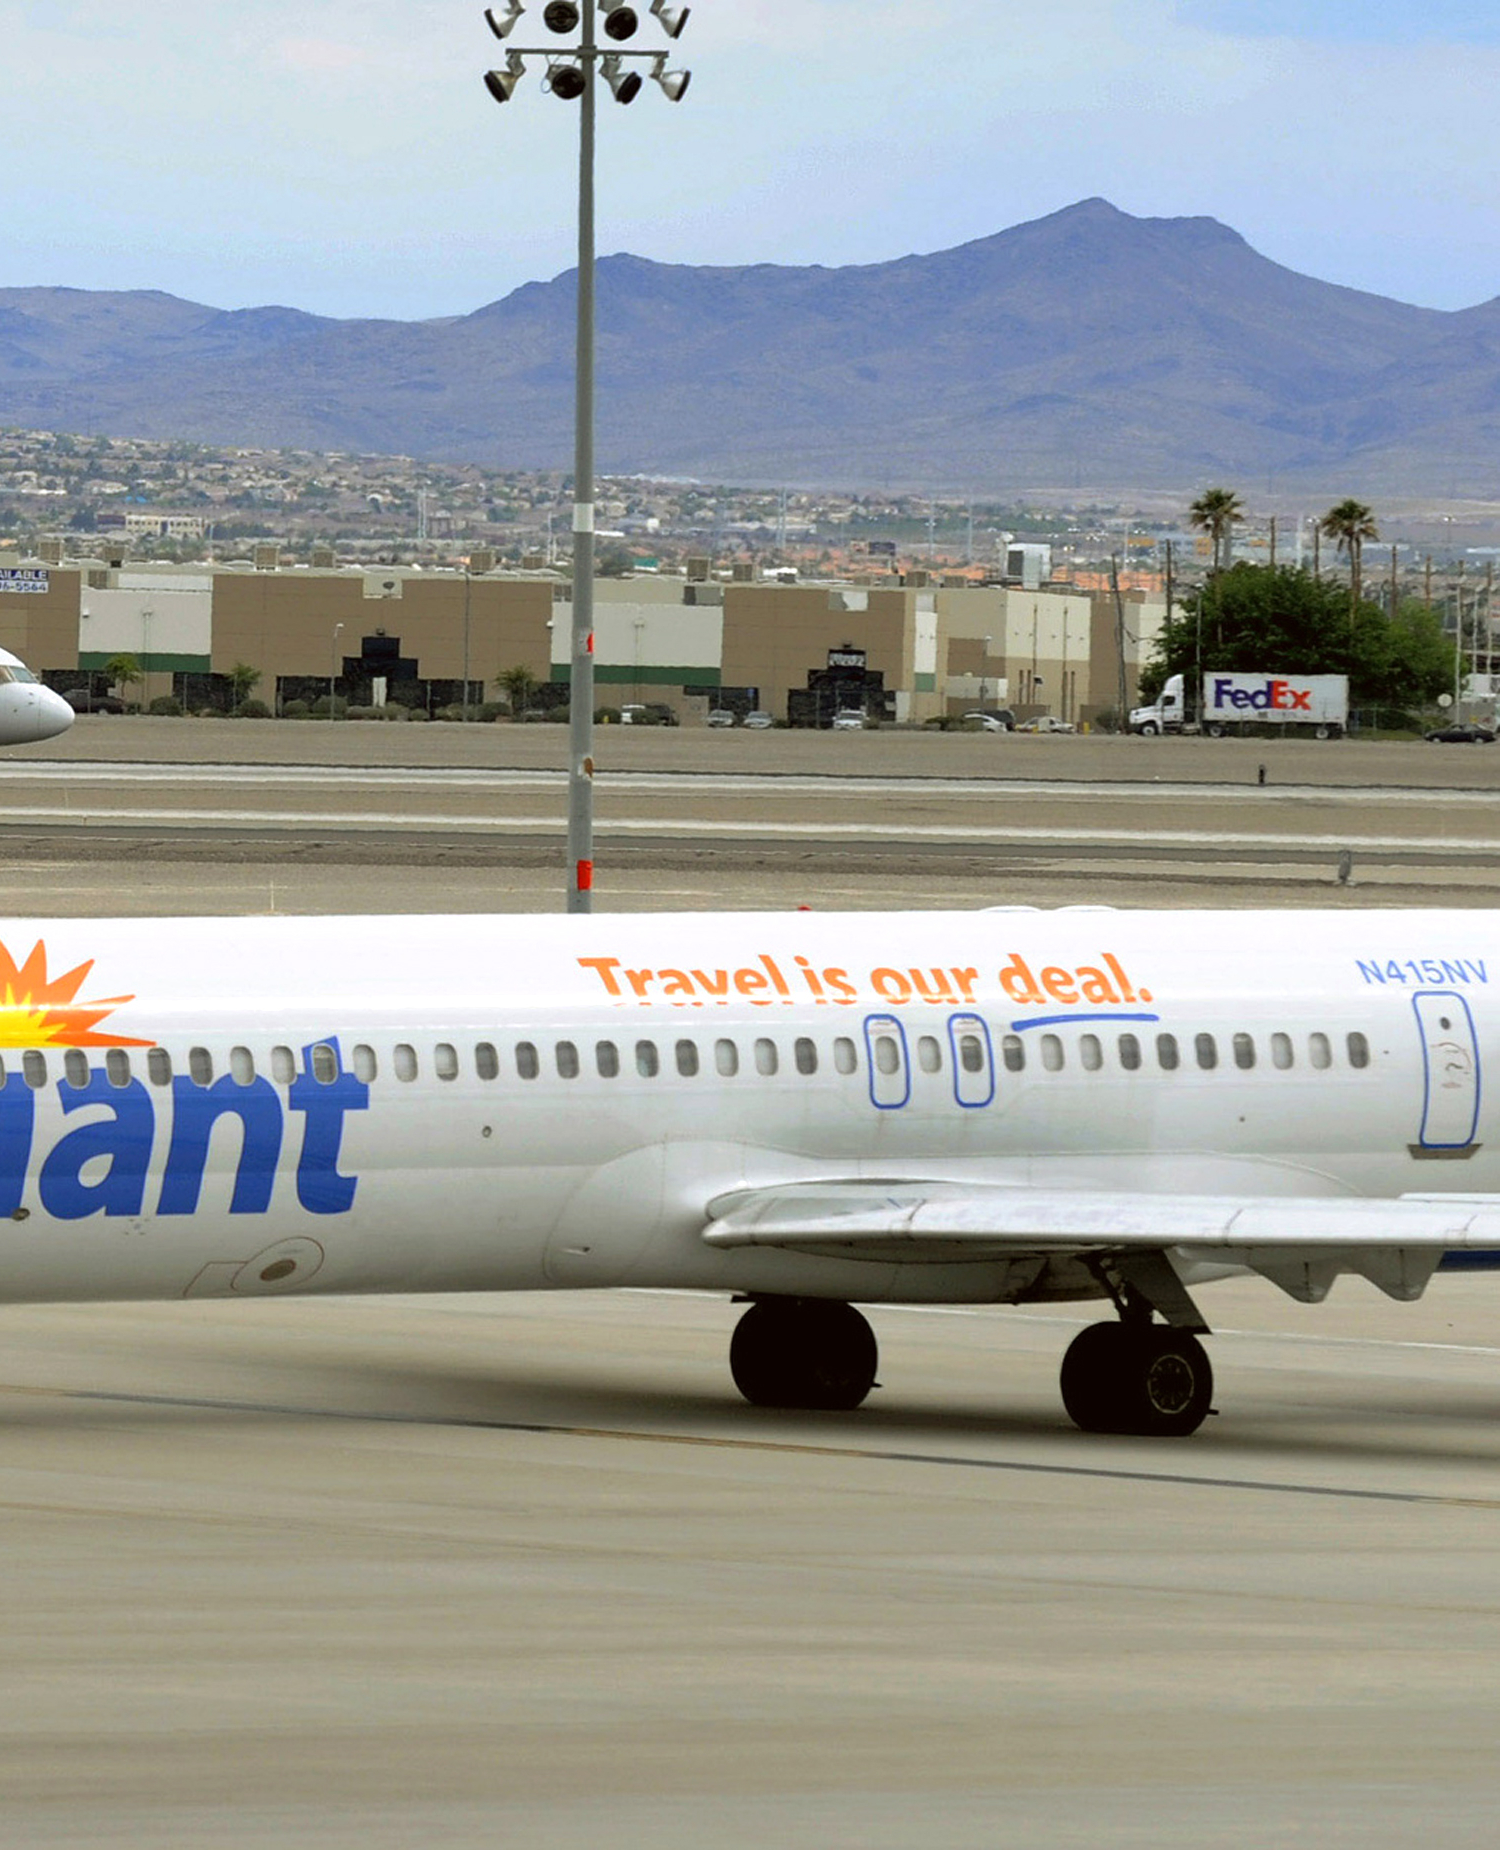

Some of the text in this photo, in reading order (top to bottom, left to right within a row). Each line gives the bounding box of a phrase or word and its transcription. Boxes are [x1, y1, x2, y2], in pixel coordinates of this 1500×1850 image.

[1214, 679, 1312, 711] FedEx
[576, 953, 1154, 1006] Travel is our deal.
[1355, 959, 1488, 984] N415NV
